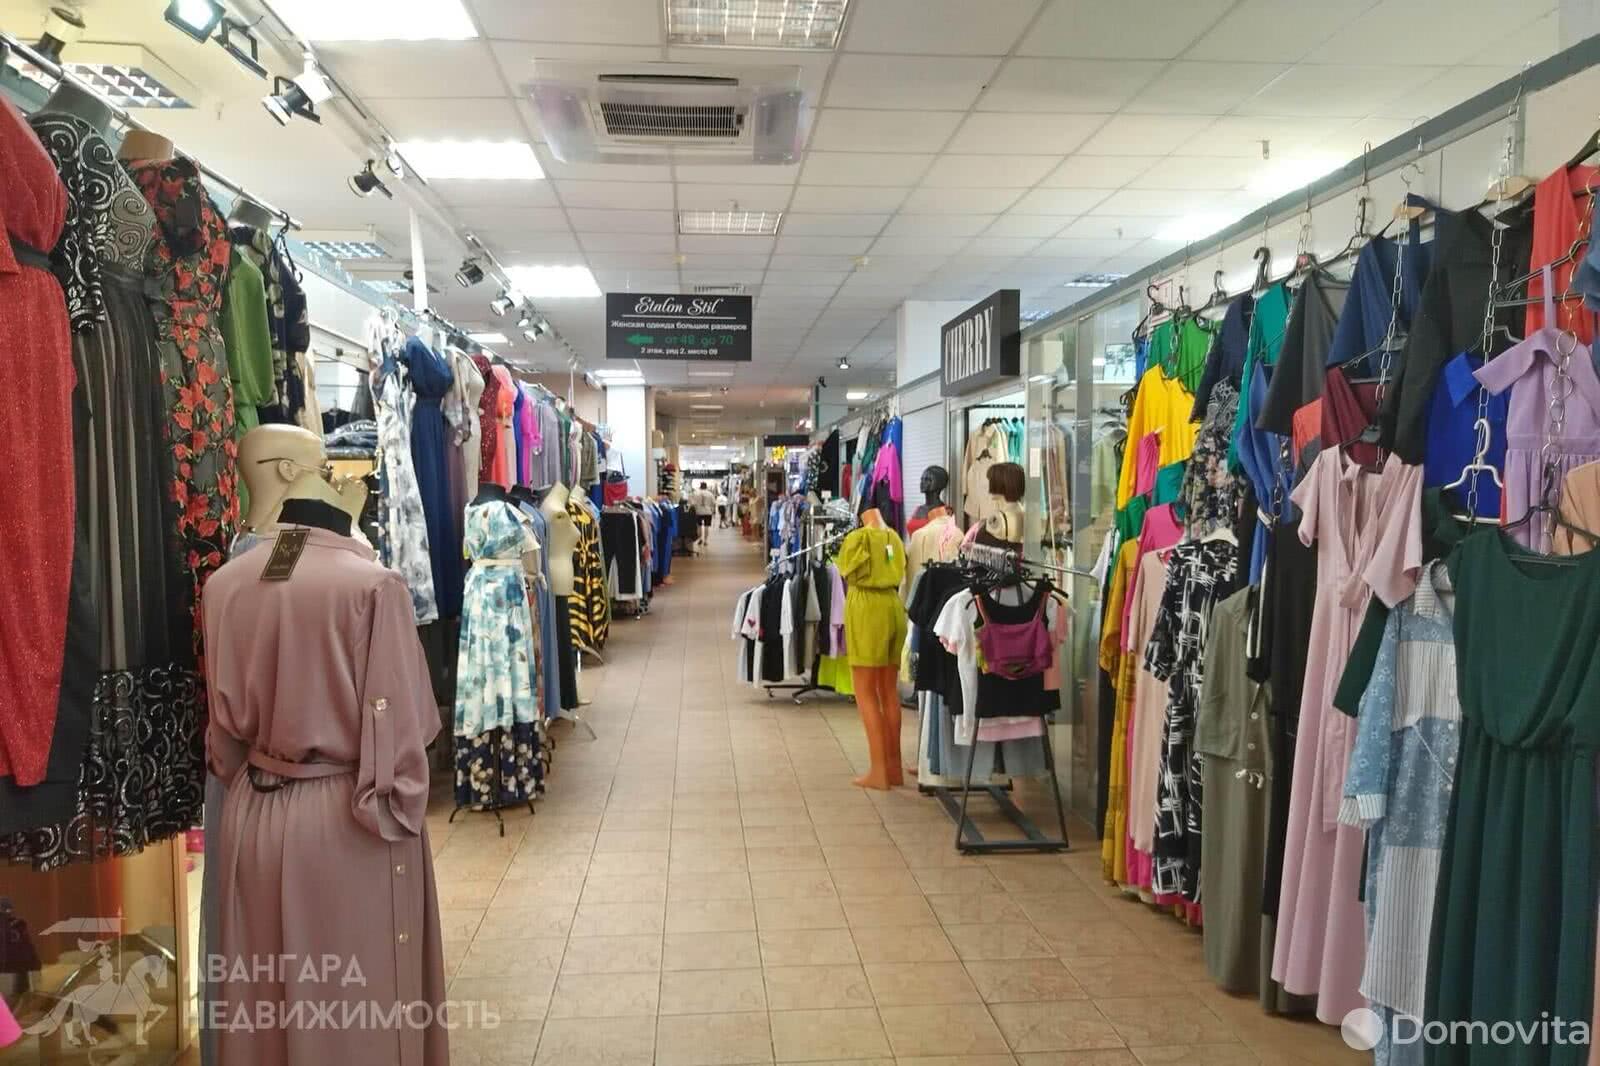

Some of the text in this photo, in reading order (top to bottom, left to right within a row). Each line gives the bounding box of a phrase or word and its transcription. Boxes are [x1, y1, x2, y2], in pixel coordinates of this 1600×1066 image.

[634, 296, 719, 316] Etalon Stil
[611, 320, 645, 328] Женская
[646, 321, 675, 330] одежда
[945, 306, 993, 385] CHERRY
